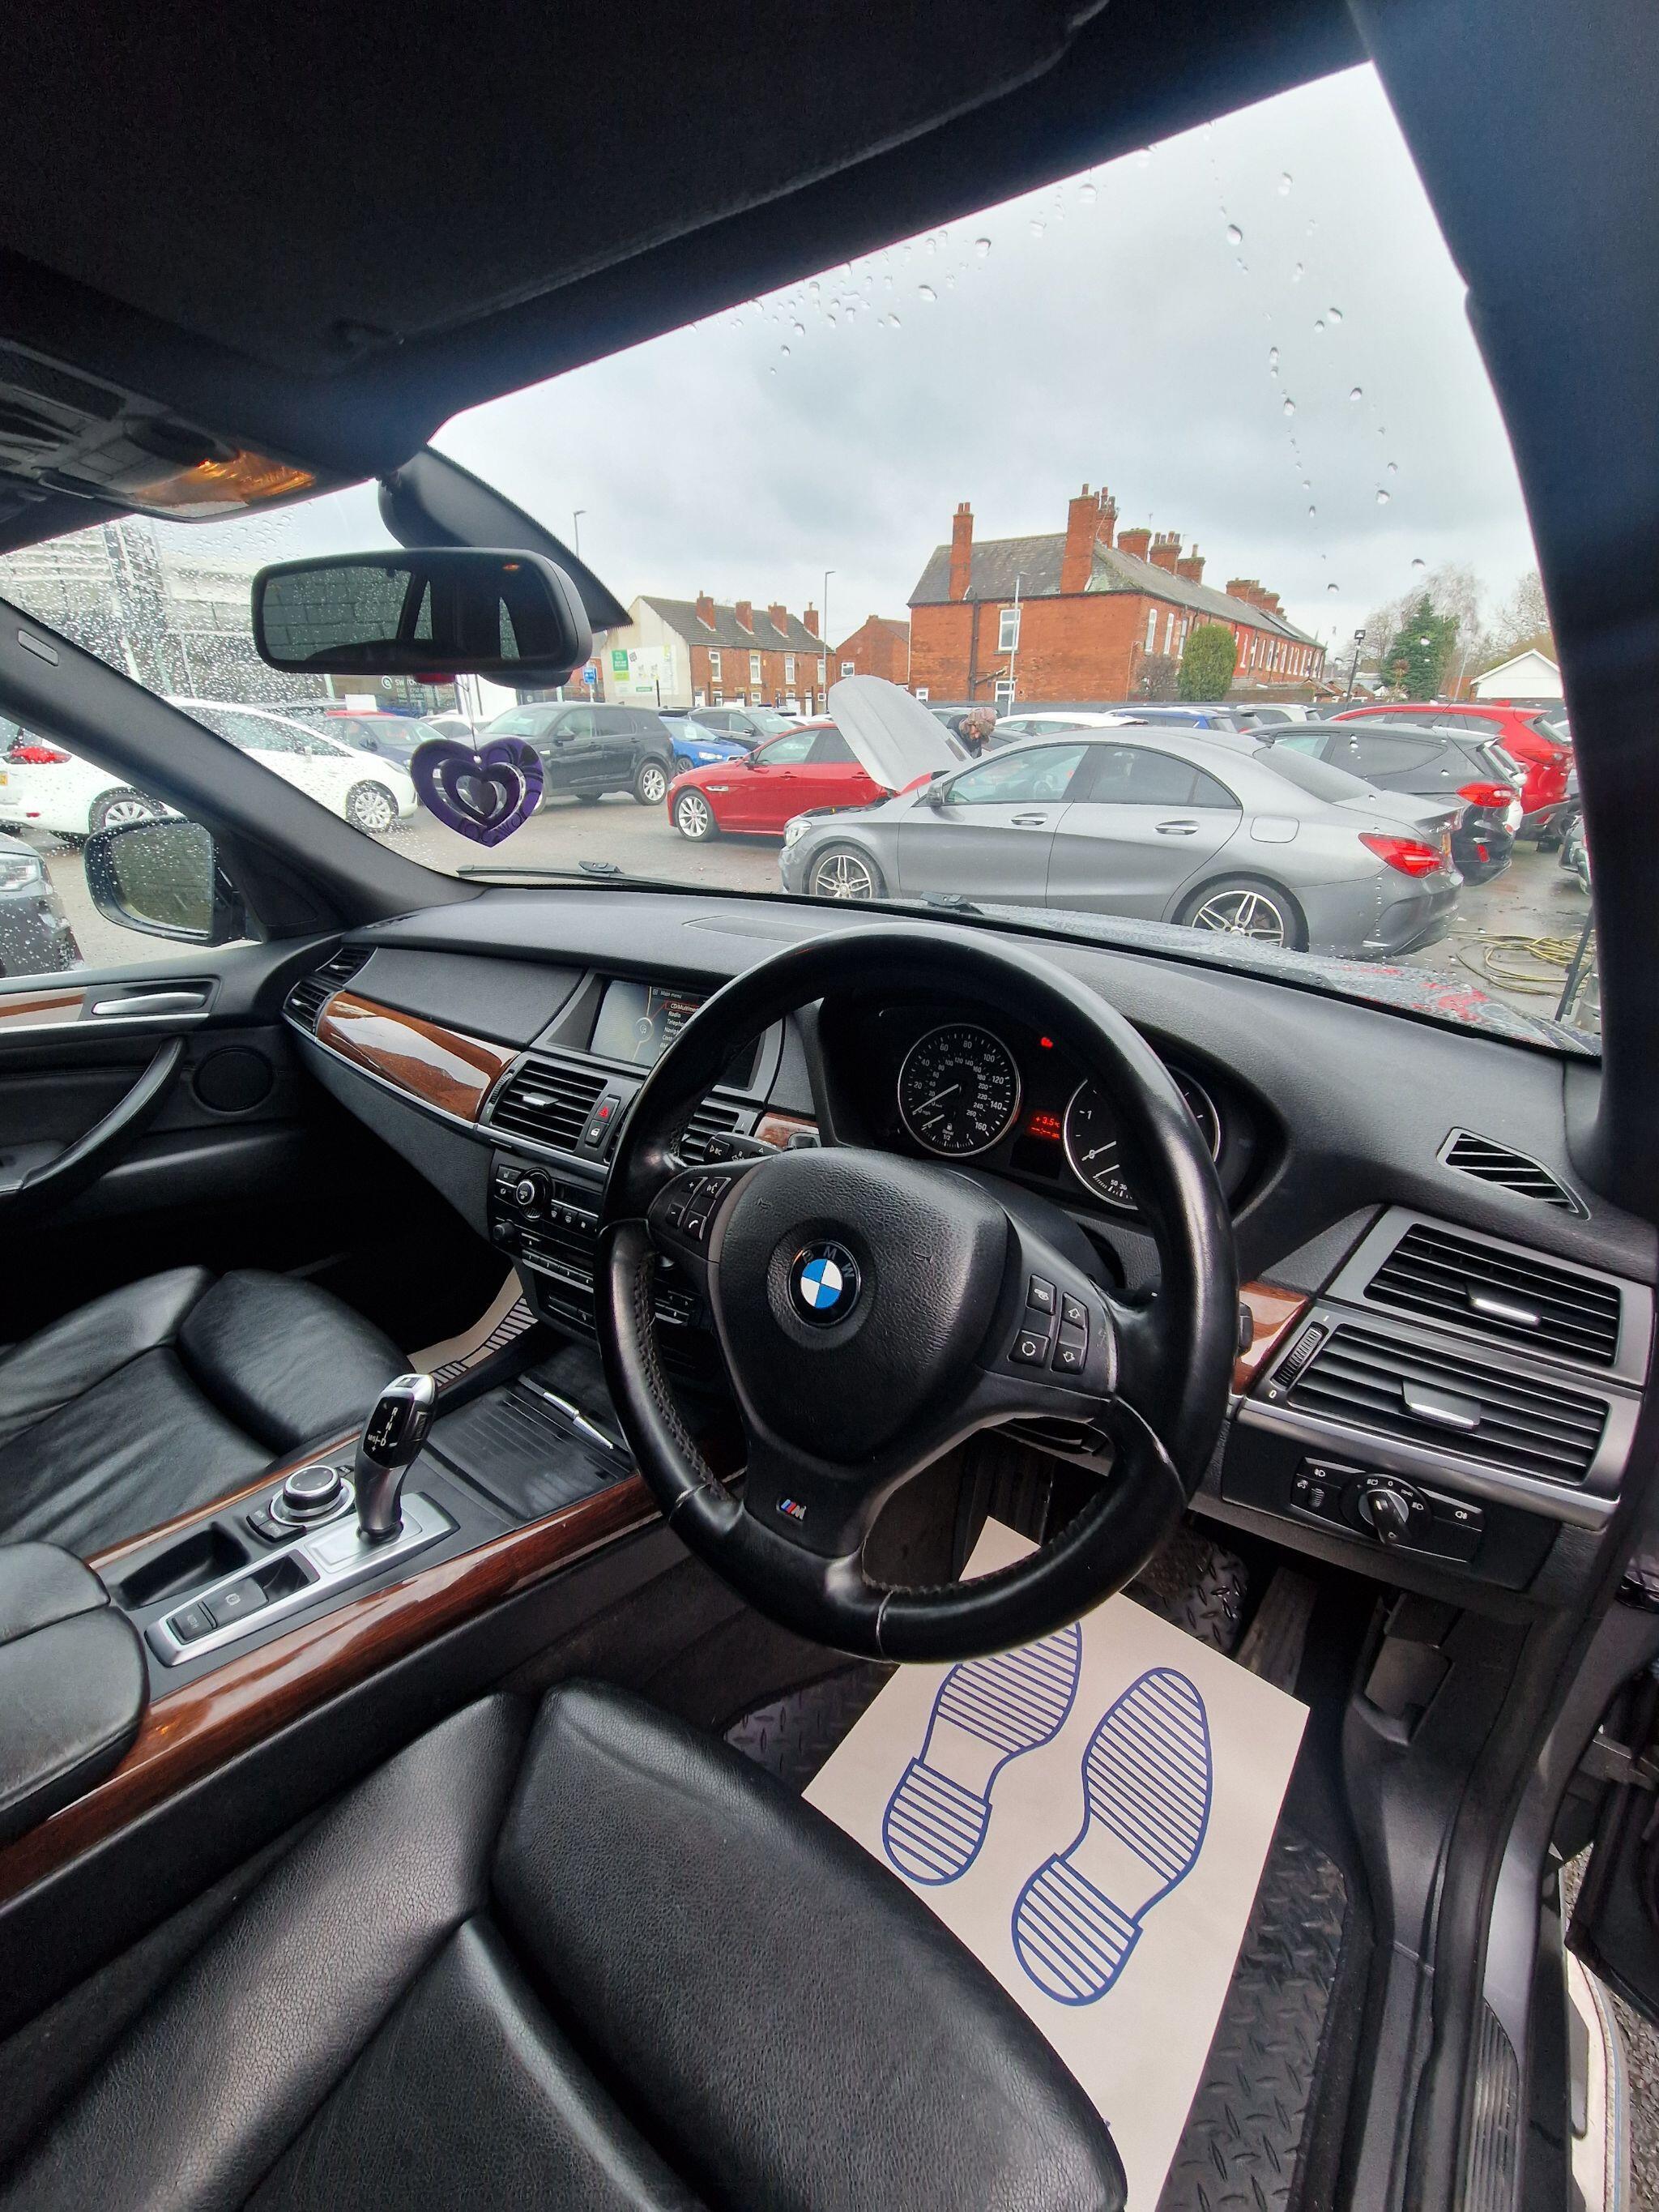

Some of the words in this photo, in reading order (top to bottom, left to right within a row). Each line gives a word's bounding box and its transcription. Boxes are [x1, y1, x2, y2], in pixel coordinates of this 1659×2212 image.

[667, 1010, 681, 1018] Radio
[940, 1044, 949, 1052] 60
[962, 1040, 972, 1049] 80
[921, 1058, 930, 1067] 40
[954, 1057, 964, 1065] 120
[983, 1053, 996, 1063] 100
[945, 1059, 954, 1067] 100
[972, 1065, 982, 1074] 160
[992, 1075, 1004, 1085] 120
[914, 1081, 923, 1090] 20
[978, 1083, 988, 1091] 200
[977, 1092, 987, 1100] 220
[973, 1102, 983, 1110] 240
[990, 1100, 1003, 1111] 140
[966, 1109, 977, 1117] 260
[1087, 1110, 1092, 1120] 1
[975, 1121, 987, 1131] 160
[802, 1245, 855, 1278] BMW
